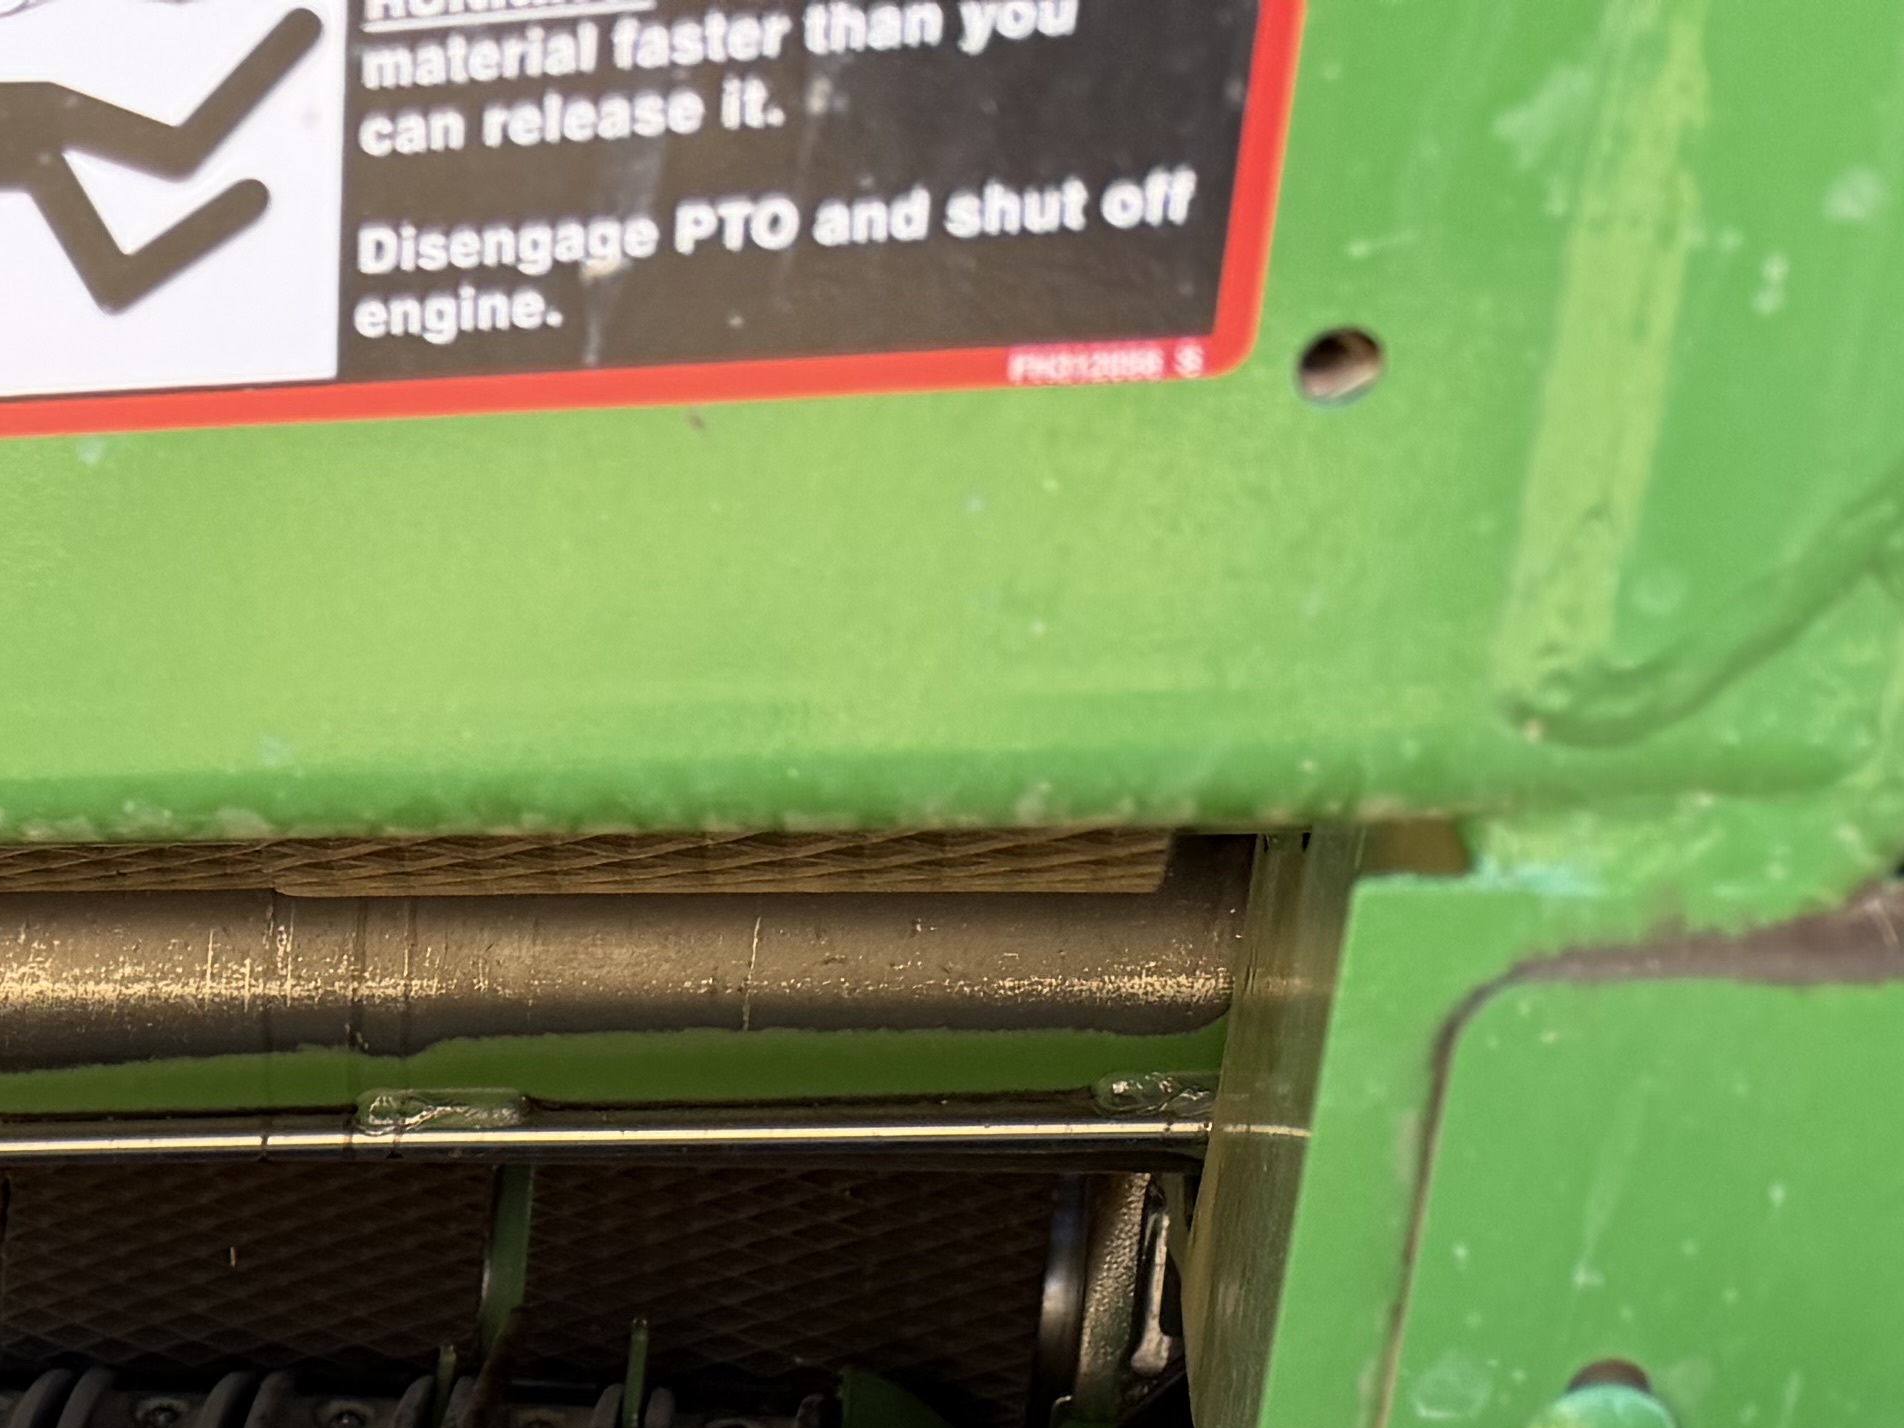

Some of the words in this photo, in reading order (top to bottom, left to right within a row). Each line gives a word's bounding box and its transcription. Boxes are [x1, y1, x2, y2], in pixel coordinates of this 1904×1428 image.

[361, 22, 598, 90] material
[612, 10, 792, 71] faster
[804, 1, 943, 54] than
[959, 0, 1079, 55] you
[359, 110, 465, 157] can
[482, 90, 705, 148] release
[720, 73, 786, 130] it.
[357, 217, 659, 276] Disengage
[674, 197, 800, 255] PTO
[813, 183, 930, 246] and
[944, 178, 1088, 238] shut
[1100, 164, 1197, 229] off
[354, 281, 563, 345] engine.
